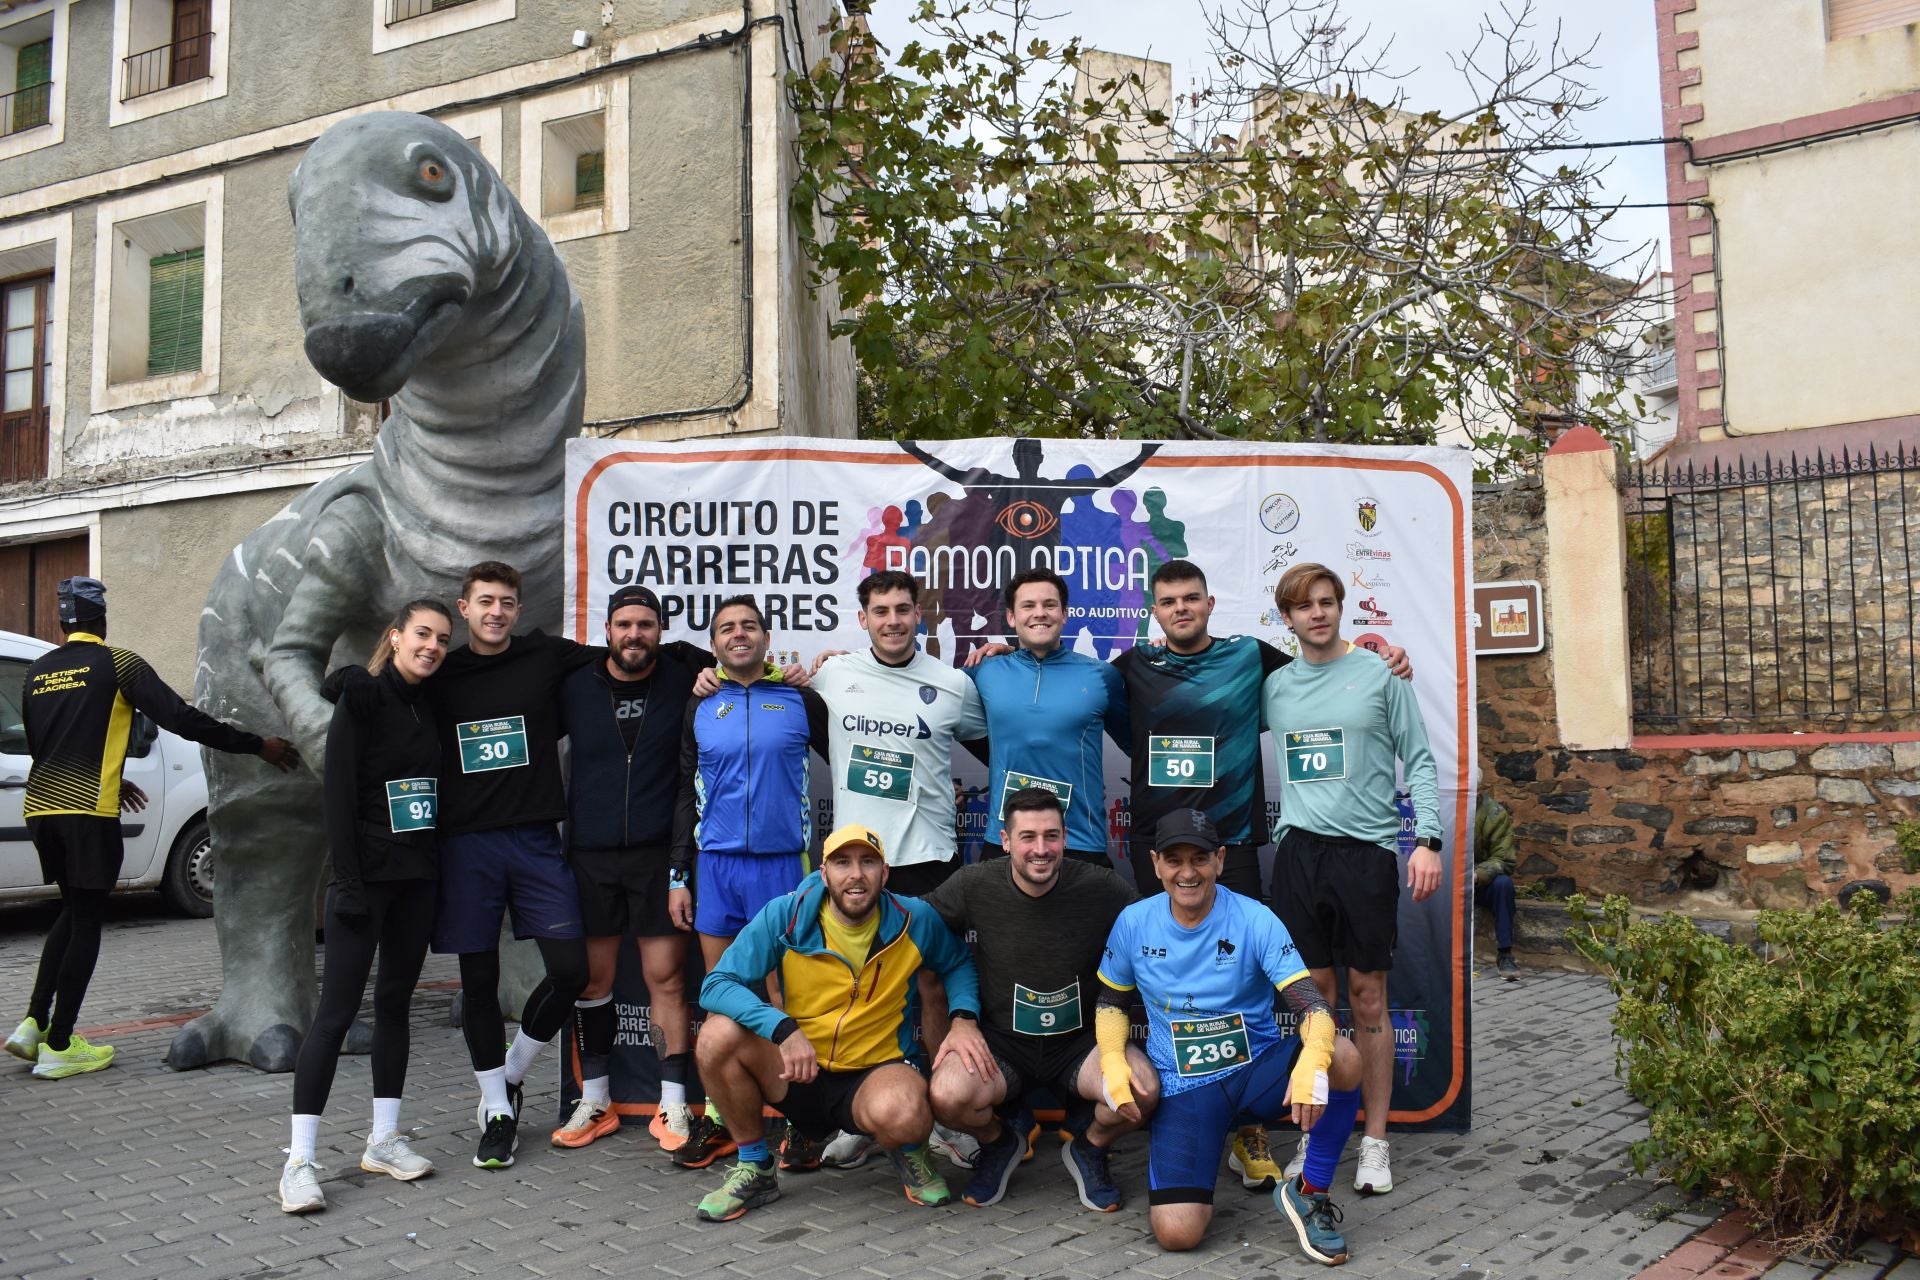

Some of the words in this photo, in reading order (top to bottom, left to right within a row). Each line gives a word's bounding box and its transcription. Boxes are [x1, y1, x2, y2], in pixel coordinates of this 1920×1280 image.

[608, 500, 778, 537] CIRCUITO
[793, 500, 839, 536] DE
[607, 544, 840, 586] CARRERAS
[886, 545, 1016, 590] RAMON
[609, 594, 840, 631] PURES
[1088, 607, 1149, 619] AUDITIVO
[33, 666, 91, 682] ATLETISMO
[32, 680, 87, 696] AZAGRESA
[842, 714, 915, 738] Clipper
[478, 740, 509, 762] 30
[1166, 759, 1195, 778] 50
[1298, 752, 1327, 772] 70
[863, 769, 893, 790] 59
[409, 800, 432, 820] 92
[956, 812, 989, 828] OPTIC
[1039, 1012, 1056, 1027] 9
[1394, 1028, 1417, 1044] TICA
[1186, 1039, 1237, 1066] 236
